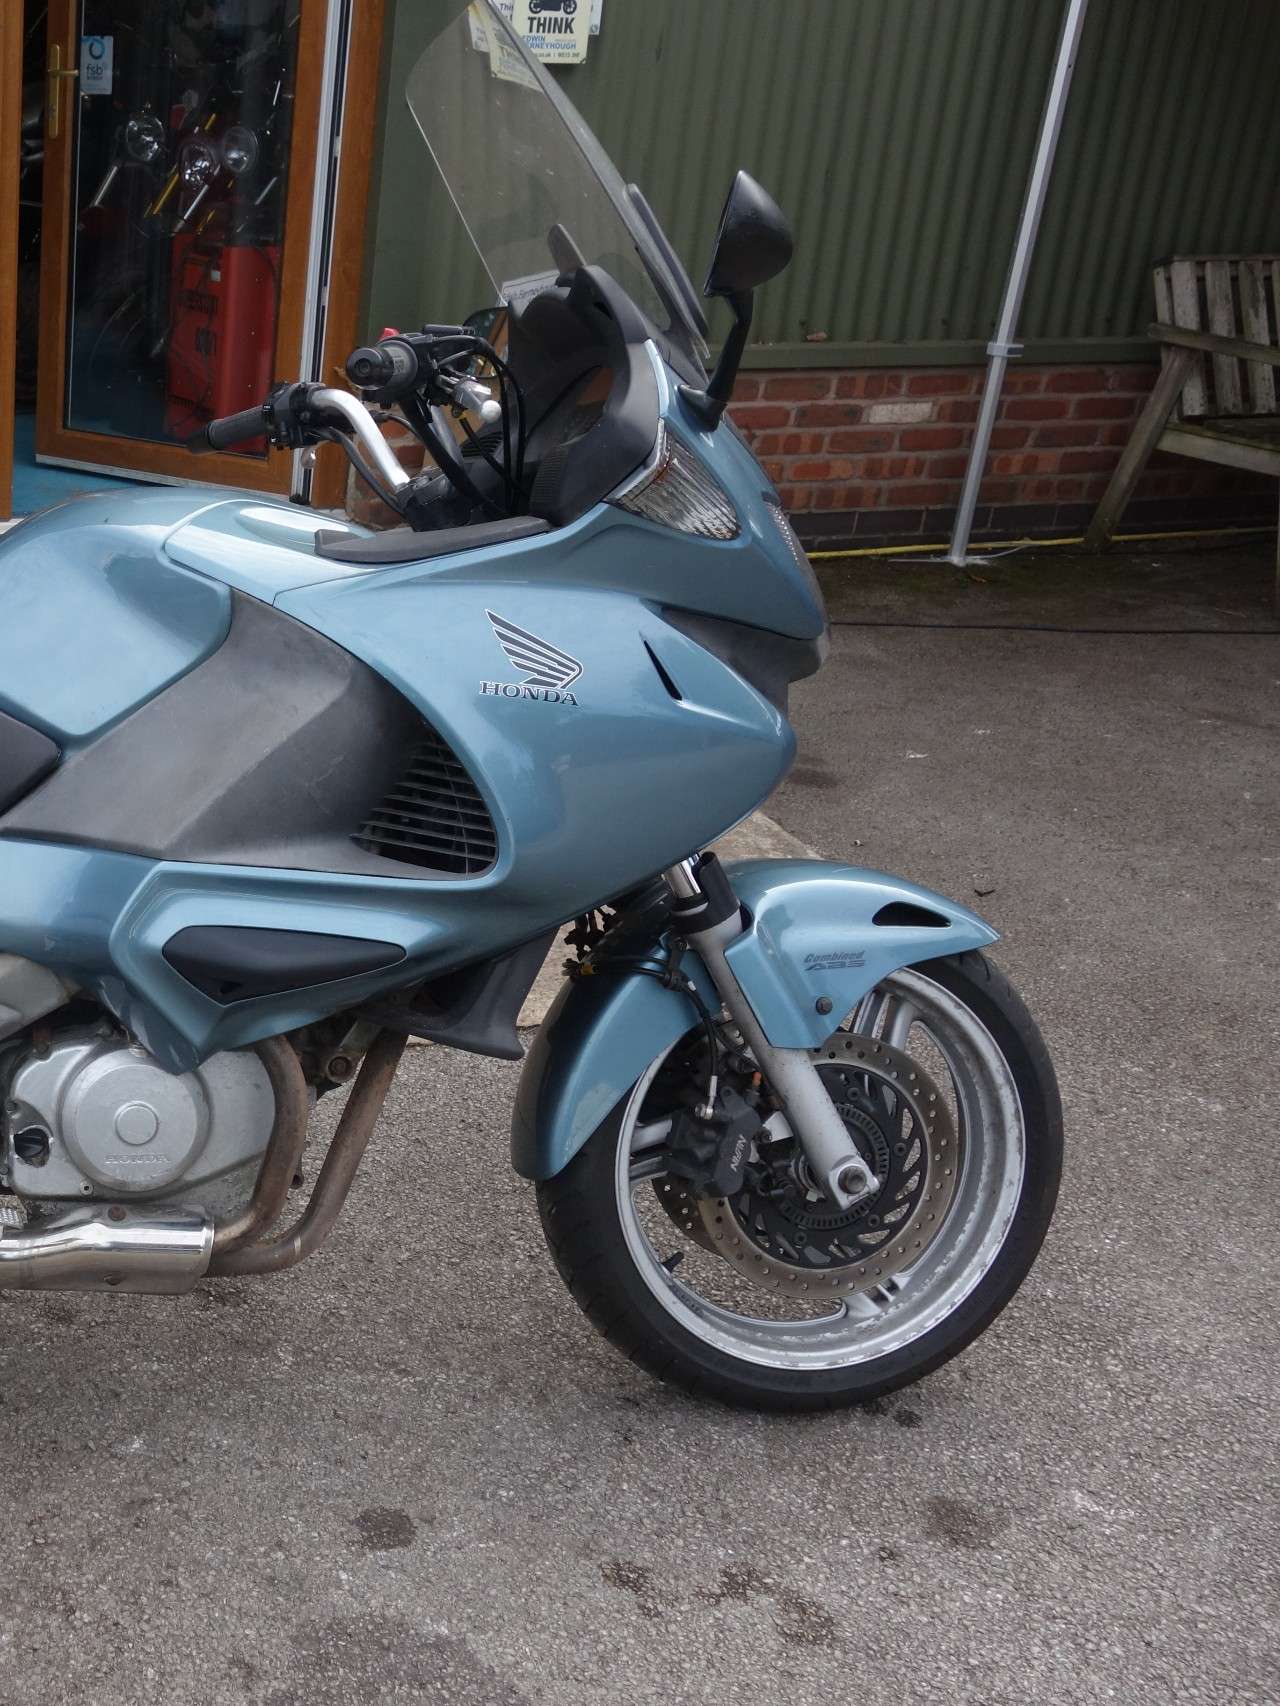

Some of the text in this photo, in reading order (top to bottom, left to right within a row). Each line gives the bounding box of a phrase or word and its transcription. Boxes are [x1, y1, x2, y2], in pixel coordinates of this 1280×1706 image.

[527, 17, 575, 34] THINK
[480, 681, 579, 706] HONDA
[104, 1153, 170, 1165] HONDA
